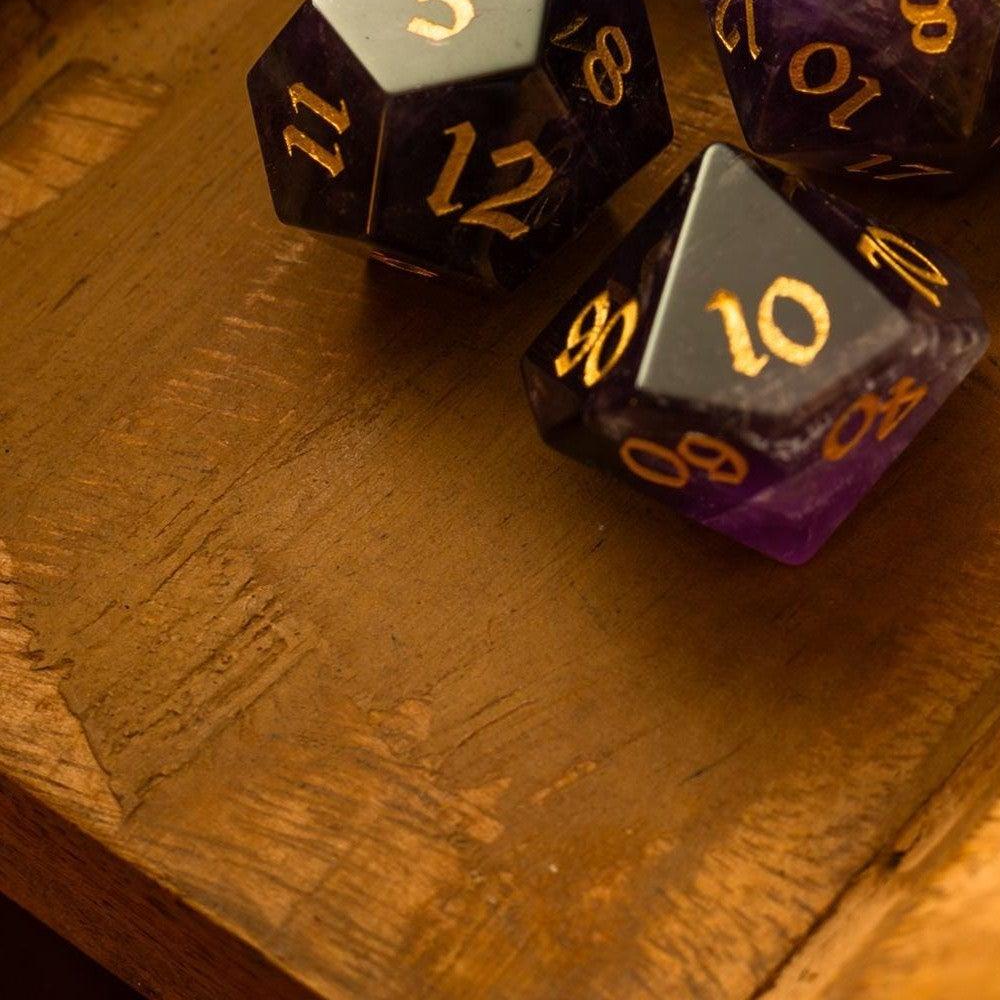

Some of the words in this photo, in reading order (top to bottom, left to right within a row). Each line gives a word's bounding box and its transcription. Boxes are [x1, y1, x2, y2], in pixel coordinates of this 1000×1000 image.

[583, 26, 632, 108] 8
[788, 41, 882, 132] 10
[283, 81, 351, 179] 11
[425, 121, 555, 240] 12
[706, 275, 831, 378] 10
